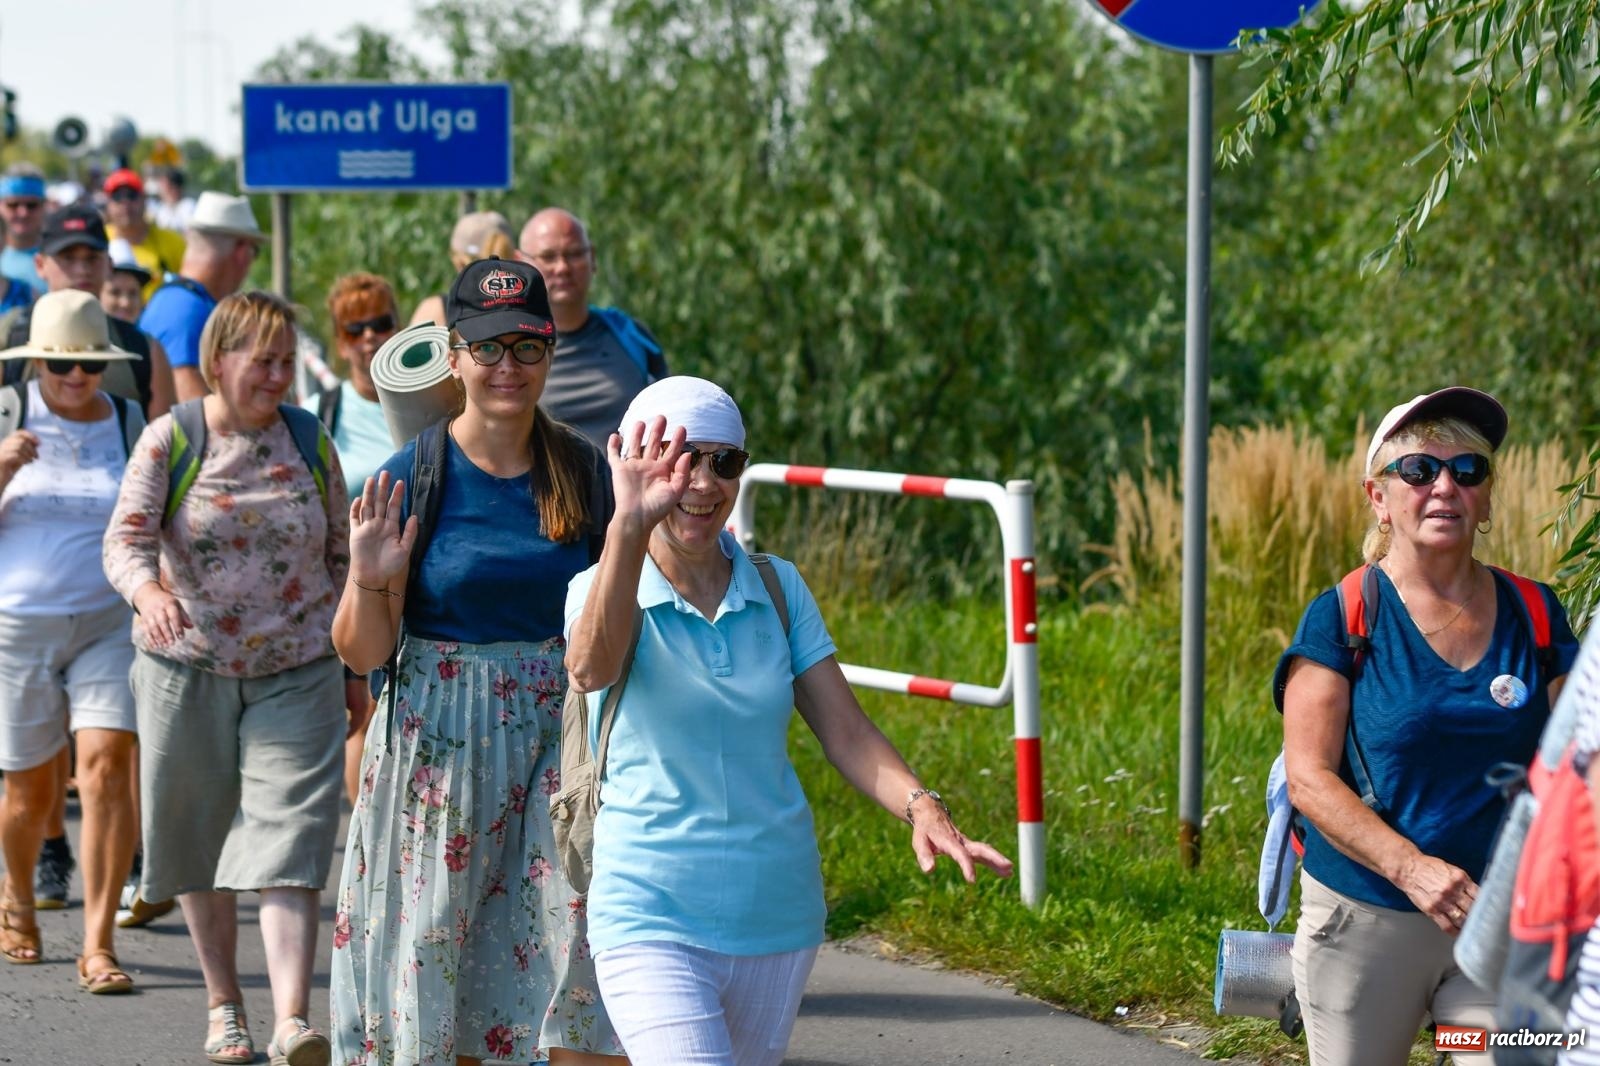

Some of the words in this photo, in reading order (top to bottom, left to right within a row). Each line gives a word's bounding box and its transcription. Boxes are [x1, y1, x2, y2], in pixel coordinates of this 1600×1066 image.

[275, 100, 382, 133] kanał
[395, 100, 477, 140] Ulga
[488, 277, 519, 291] SF
